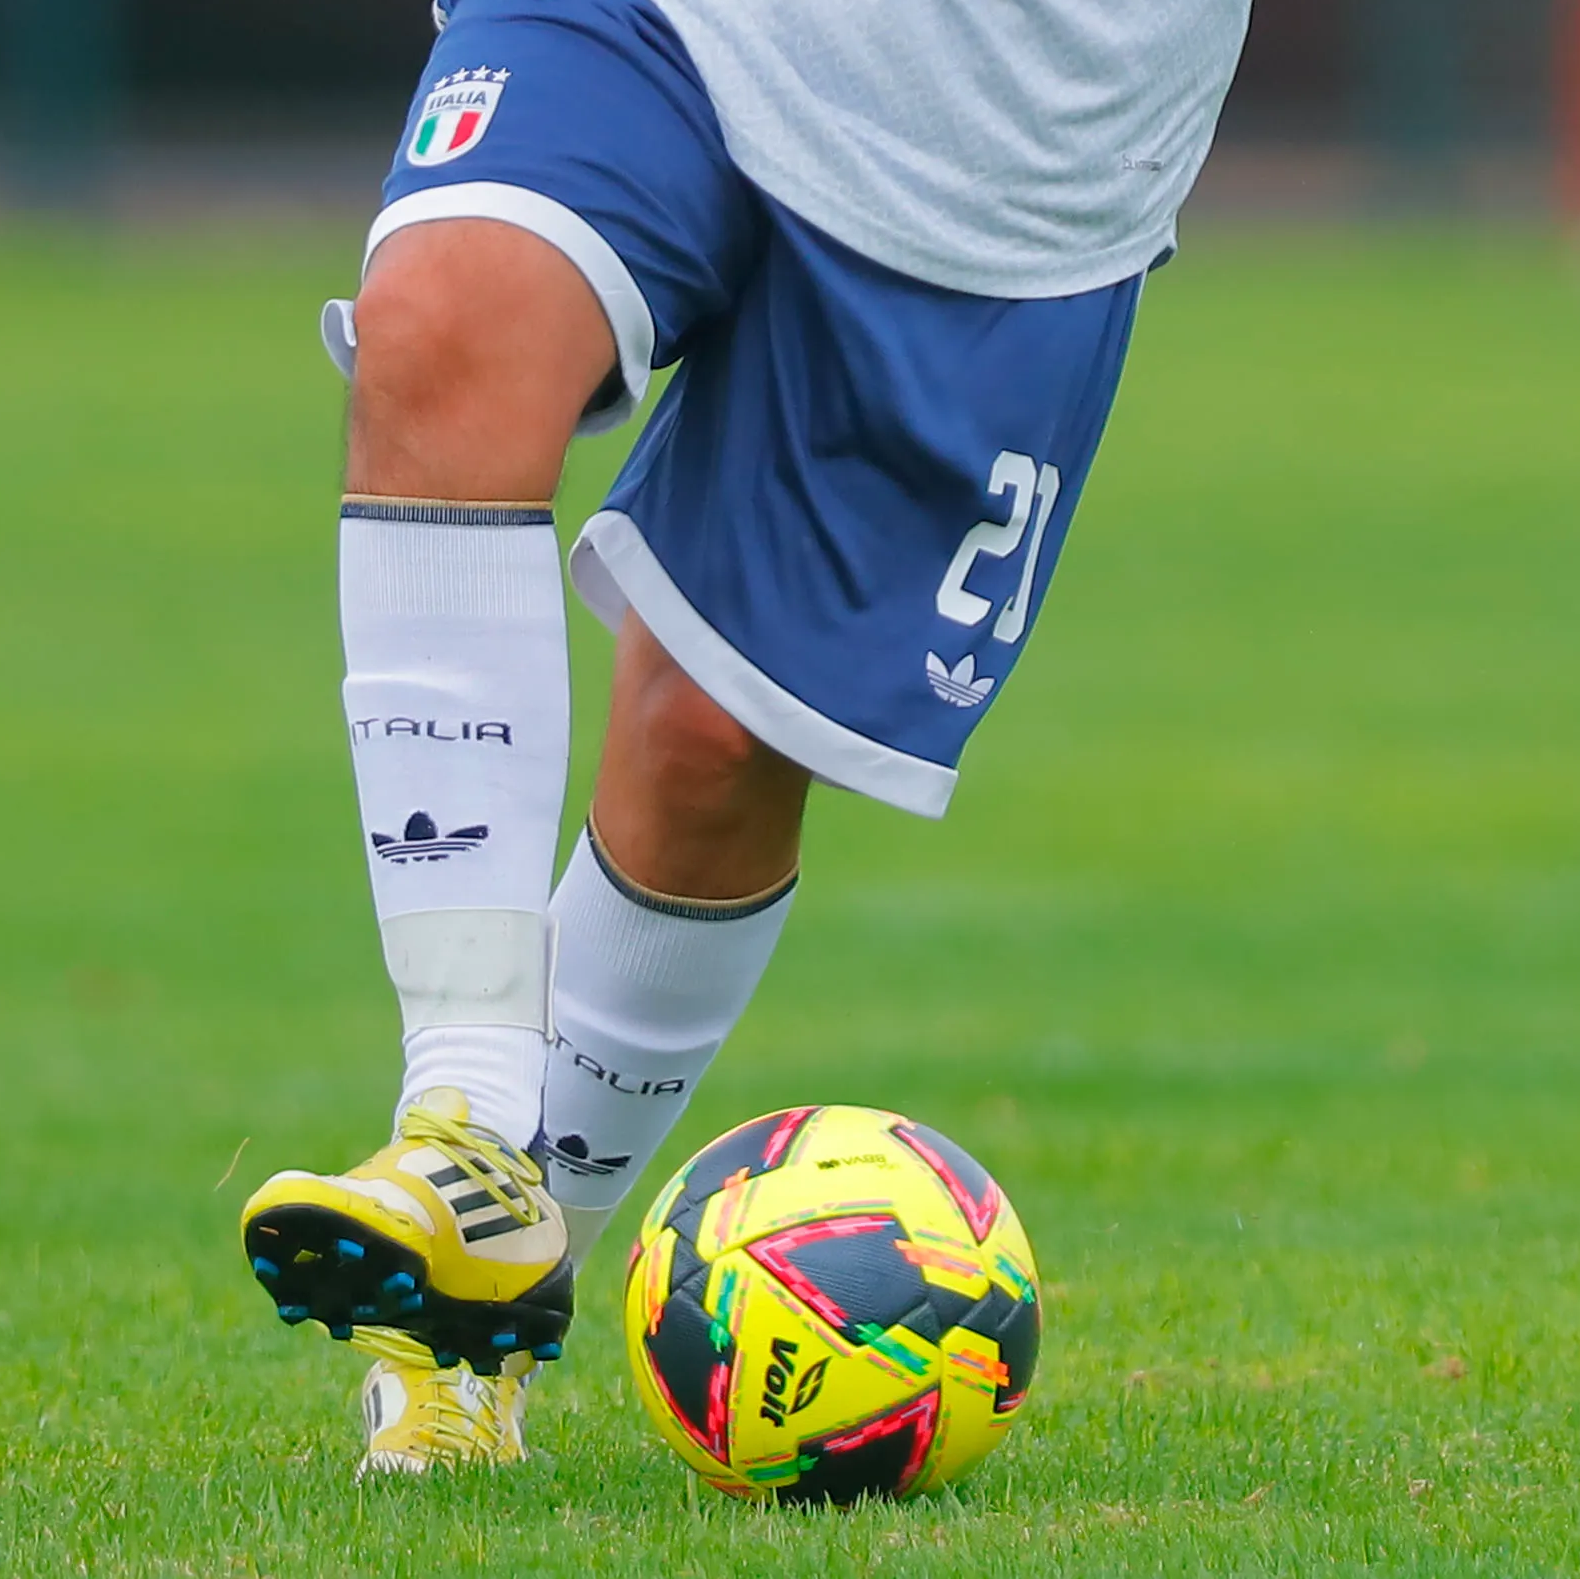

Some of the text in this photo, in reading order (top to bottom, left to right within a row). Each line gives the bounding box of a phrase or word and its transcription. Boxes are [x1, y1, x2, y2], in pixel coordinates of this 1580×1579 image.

[428, 90, 487, 112] ITALIA
[351, 717, 513, 746] ITALIA
[556, 1029, 686, 1096] TALIA
[760, 1337, 799, 1428] Voit
